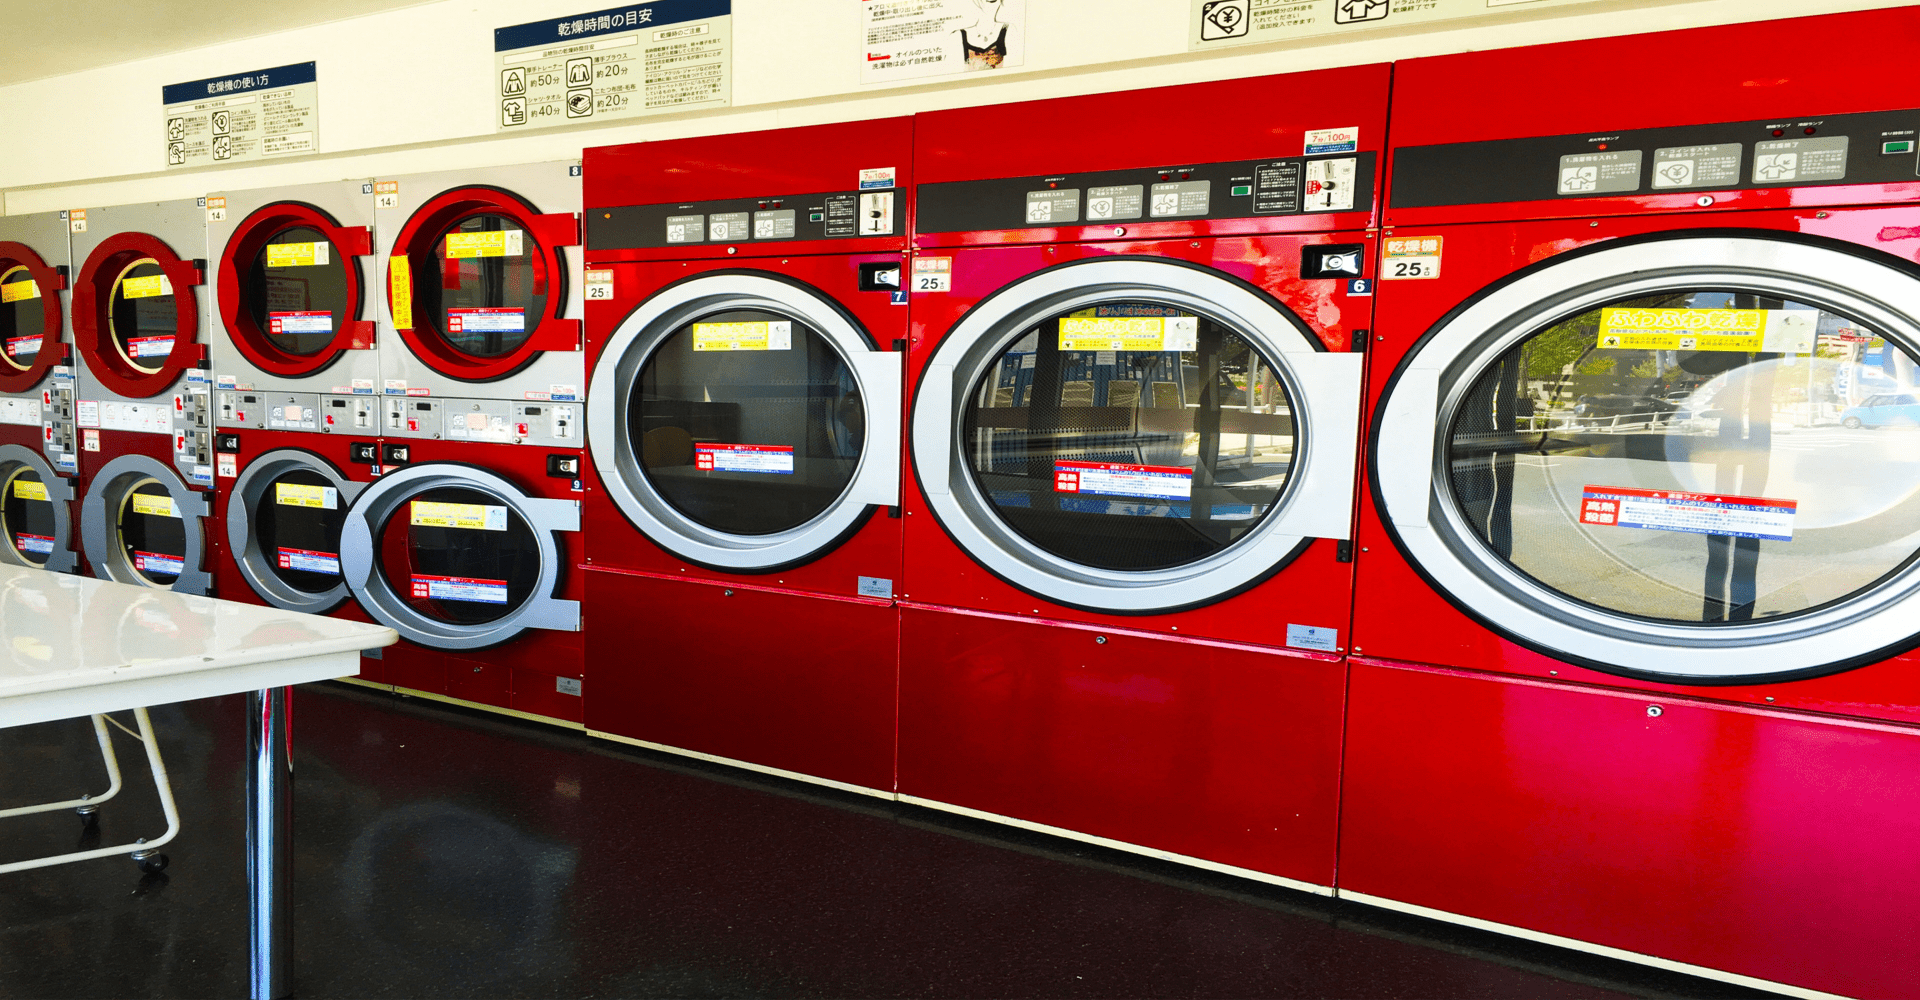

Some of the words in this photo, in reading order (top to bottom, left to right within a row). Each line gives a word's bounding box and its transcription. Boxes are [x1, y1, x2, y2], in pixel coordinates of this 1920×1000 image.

[557, 8, 653, 37] 乾燥時間の目安
[1253, 13, 1300, 24] 入れてください
[895, 47, 943, 58] オイルのついた
[596, 64, 628, 79] 約20分
[207, 74, 269, 94] 乾燥機の使い方
[530, 74, 560, 88] 約50分
[597, 94, 629, 108] 約20分
[530, 105, 561, 118] 約40分
[572, 166, 578, 176] 8
[363, 185, 371, 193] 10
[198, 198, 205, 206] 12
[380, 197, 391, 207] 14
[211, 211, 221, 220] 14
[74, 223, 82, 231] 14
[1387, 239, 1438, 252] 乾燥機
[1394, 262, 1421, 276] 25
[920, 278, 938, 289] 25
[1354, 280, 1365, 292] 6
[591, 288, 604, 298] 25
[895, 291, 903, 302] 7
[222, 467, 231, 475] 14
[371, 465, 379, 473] 11
[573, 480, 580, 489] 9
